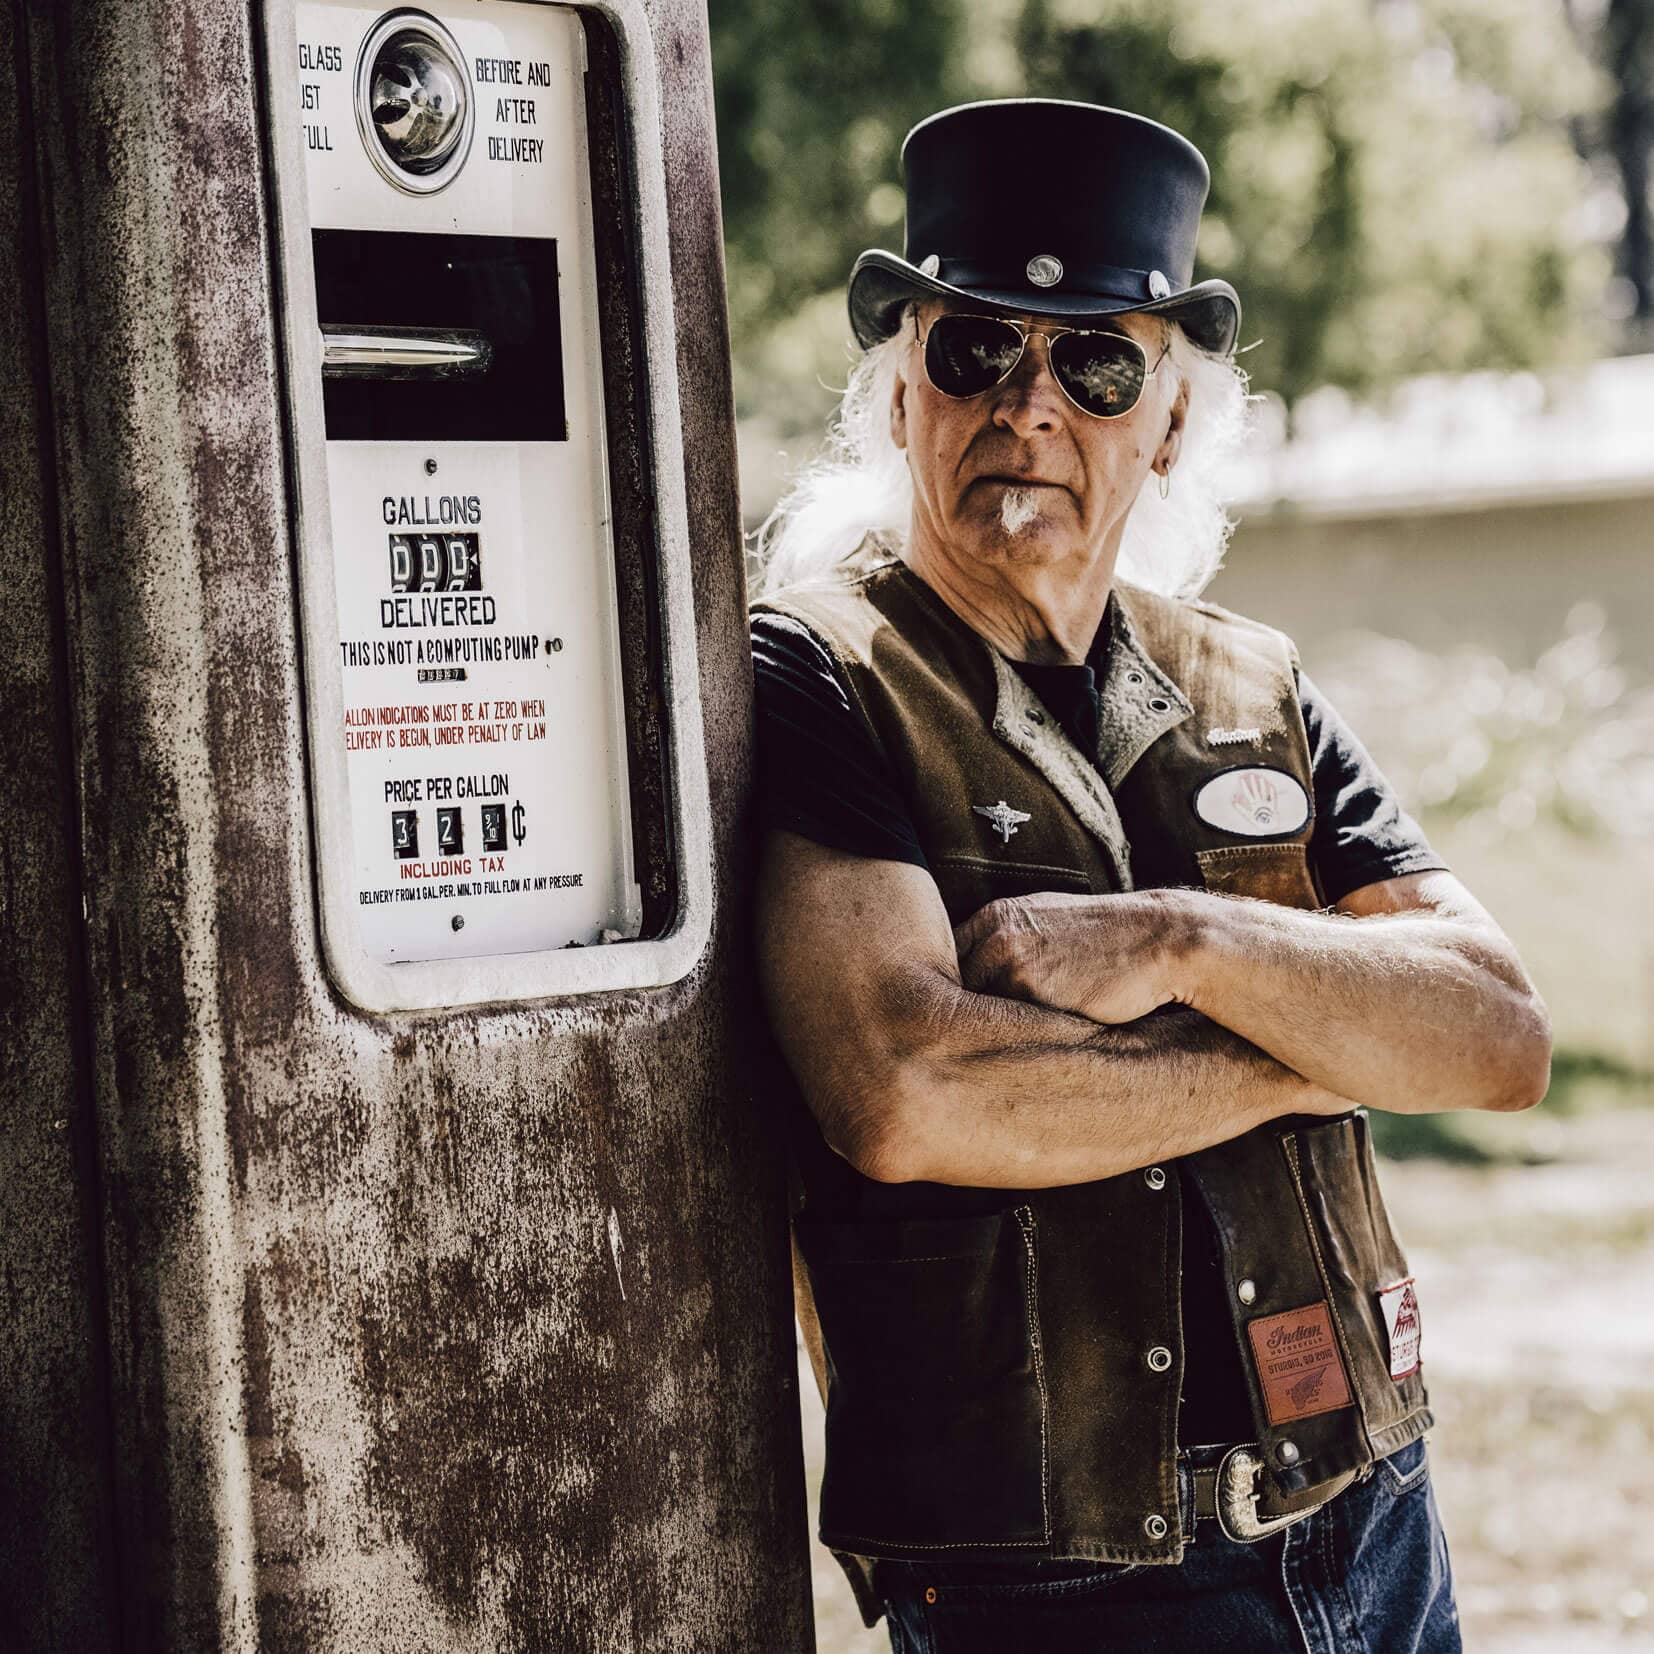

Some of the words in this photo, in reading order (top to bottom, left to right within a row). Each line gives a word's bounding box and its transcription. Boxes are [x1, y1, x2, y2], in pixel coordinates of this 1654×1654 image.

[298, 44, 342, 71] GLASS
[475, 58, 522, 85] BEFORE
[528, 62, 551, 87] AND
[496, 98, 536, 124] AFTER
[488, 136, 544, 163] DELIVERY
[382, 496, 482, 525] GALLONS
[380, 596, 497, 628] DELIVERED
[340, 641, 370, 666] THIS
[374, 641, 385, 665] IS
[387, 640, 413, 664] NOT
[417, 640, 424, 664] A
[427, 637, 502, 663] COMPUTING
[504, 635, 539, 660] PUMP
[345, 707, 375, 726] ALLON
[377, 705, 430, 725] INDICATIONS
[433, 703, 457, 722] MUST
[462, 703, 474, 720] BE
[479, 702, 489, 720] AT
[494, 701, 517, 719] ZERO
[521, 699, 545, 718] WHEN
[346, 730, 382, 750] ELIVERY
[387, 730, 395, 748] IS
[400, 728, 432, 748] BEGUN,
[435, 726, 464, 745] UNDER
[468, 724, 507, 743] PENALTY
[512, 723, 523, 741] OF
[527, 722, 546, 740] LAW
[384, 779, 422, 803] PRICE
[427, 777, 452, 800] PER
[457, 773, 509, 798] GALLON
[396, 818, 408, 845] 3
[441, 816, 453, 842] 2
[400, 859, 471, 879] INCLUDING
[479, 857, 504, 873] TAX
[360, 889, 394, 905] DELIVERY
[396, 887, 415, 902] FROM
[416, 887, 421, 900] 1
[472, 882, 482, 895] TO
[484, 880, 501, 895] FULL
[503, 879, 520, 893] FLOW
[523, 878, 531, 891] AT
[534, 876, 547, 891] ANY
[549, 874, 583, 889] PRESSURE
[1266, 1325, 1324, 1349] Indian
